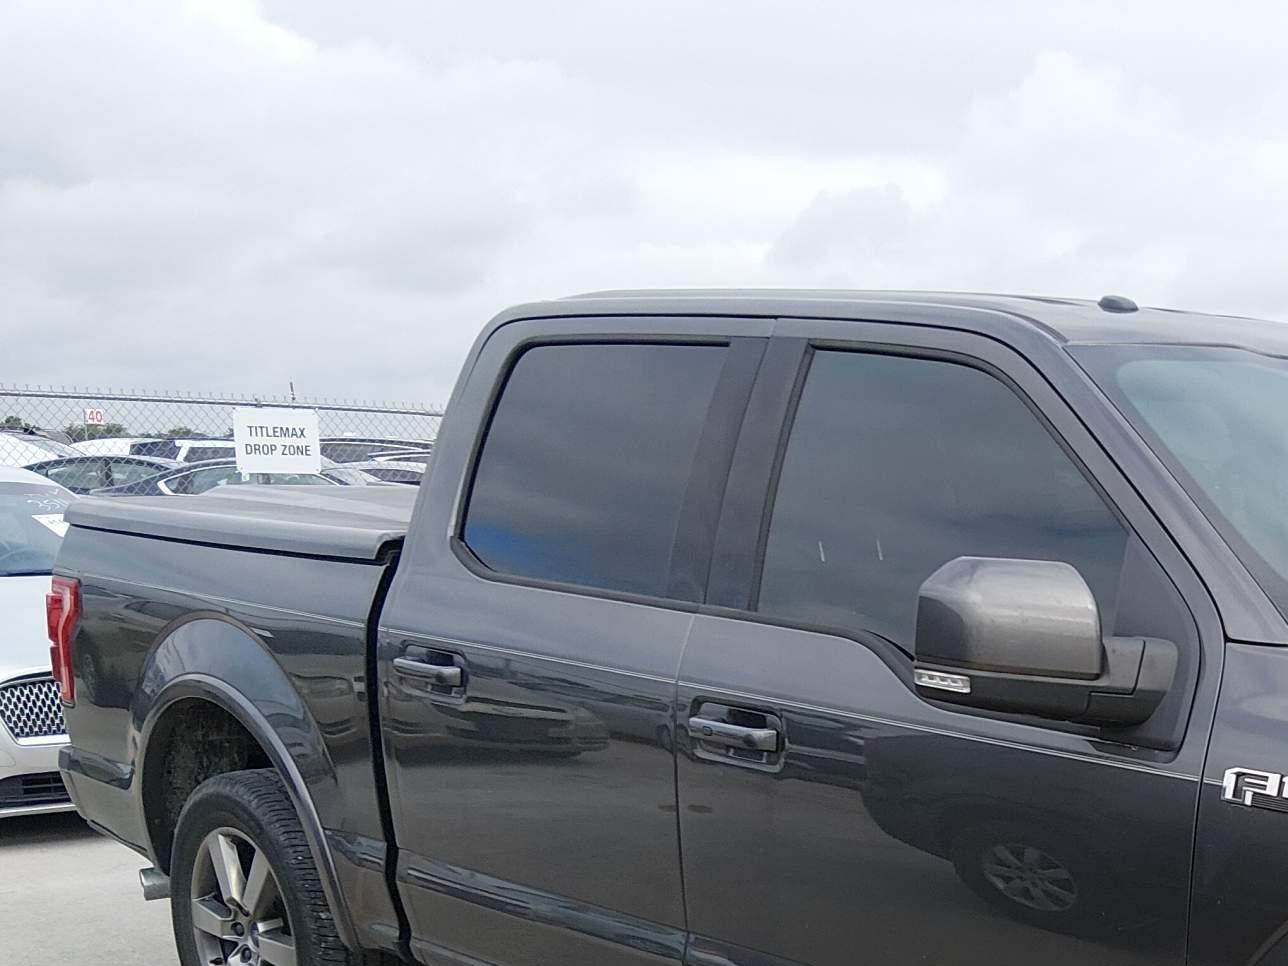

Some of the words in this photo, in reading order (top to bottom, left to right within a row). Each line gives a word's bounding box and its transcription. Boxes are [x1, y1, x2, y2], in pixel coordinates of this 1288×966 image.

[246, 425, 307, 439] TITLEMAX
[245, 443, 278, 456] DROP
[281, 444, 312, 457] ZONE
